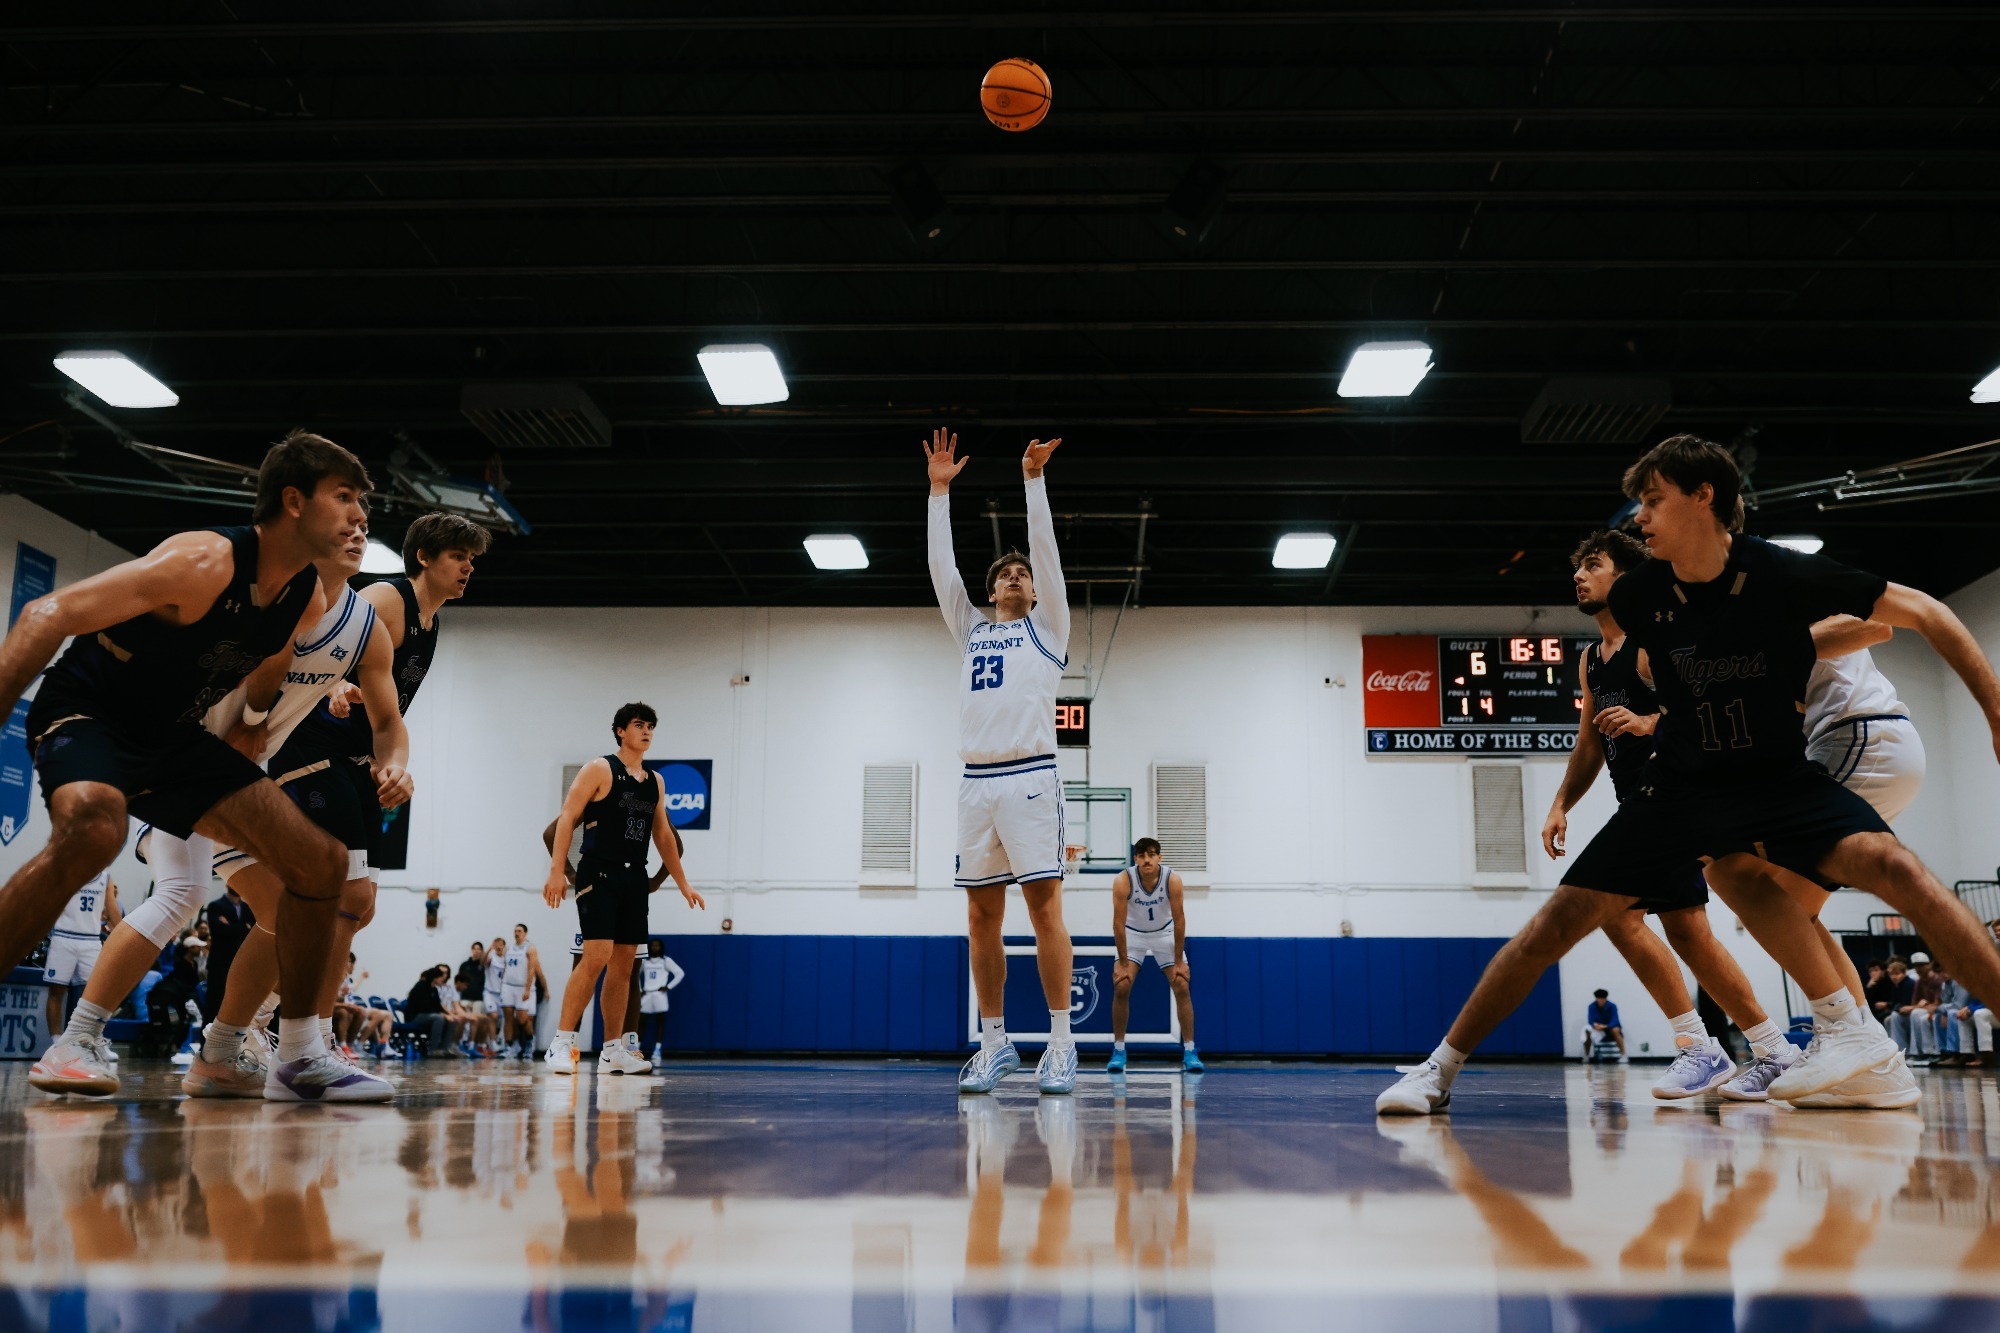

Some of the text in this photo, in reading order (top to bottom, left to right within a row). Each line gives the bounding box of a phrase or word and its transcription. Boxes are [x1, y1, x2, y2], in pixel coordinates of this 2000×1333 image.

[1449, 641, 1488, 651] GUEST
[1509, 638, 1562, 661] 16:16
[971, 655, 1004, 691] 23
[1470, 652, 1486, 675] 6
[1668, 644, 1768, 697] Tigers
[282, 671, 335, 685] NANT
[1503, 667, 1554, 684] PERIOD 1
[1462, 697, 1494, 715] 1 4
[1696, 698, 1753, 751] 11
[1394, 733, 1581, 749] HOME OF THE SCO
[625, 816, 646, 842] 22
[80, 896, 95, 912] 33
[1148, 907, 1155, 921] 1
[1071, 975, 1090, 986] OTS
[11, 988, 39, 1009] THE
[1070, 986, 1084, 1011] C
[0, 1014, 37, 1053] TS
